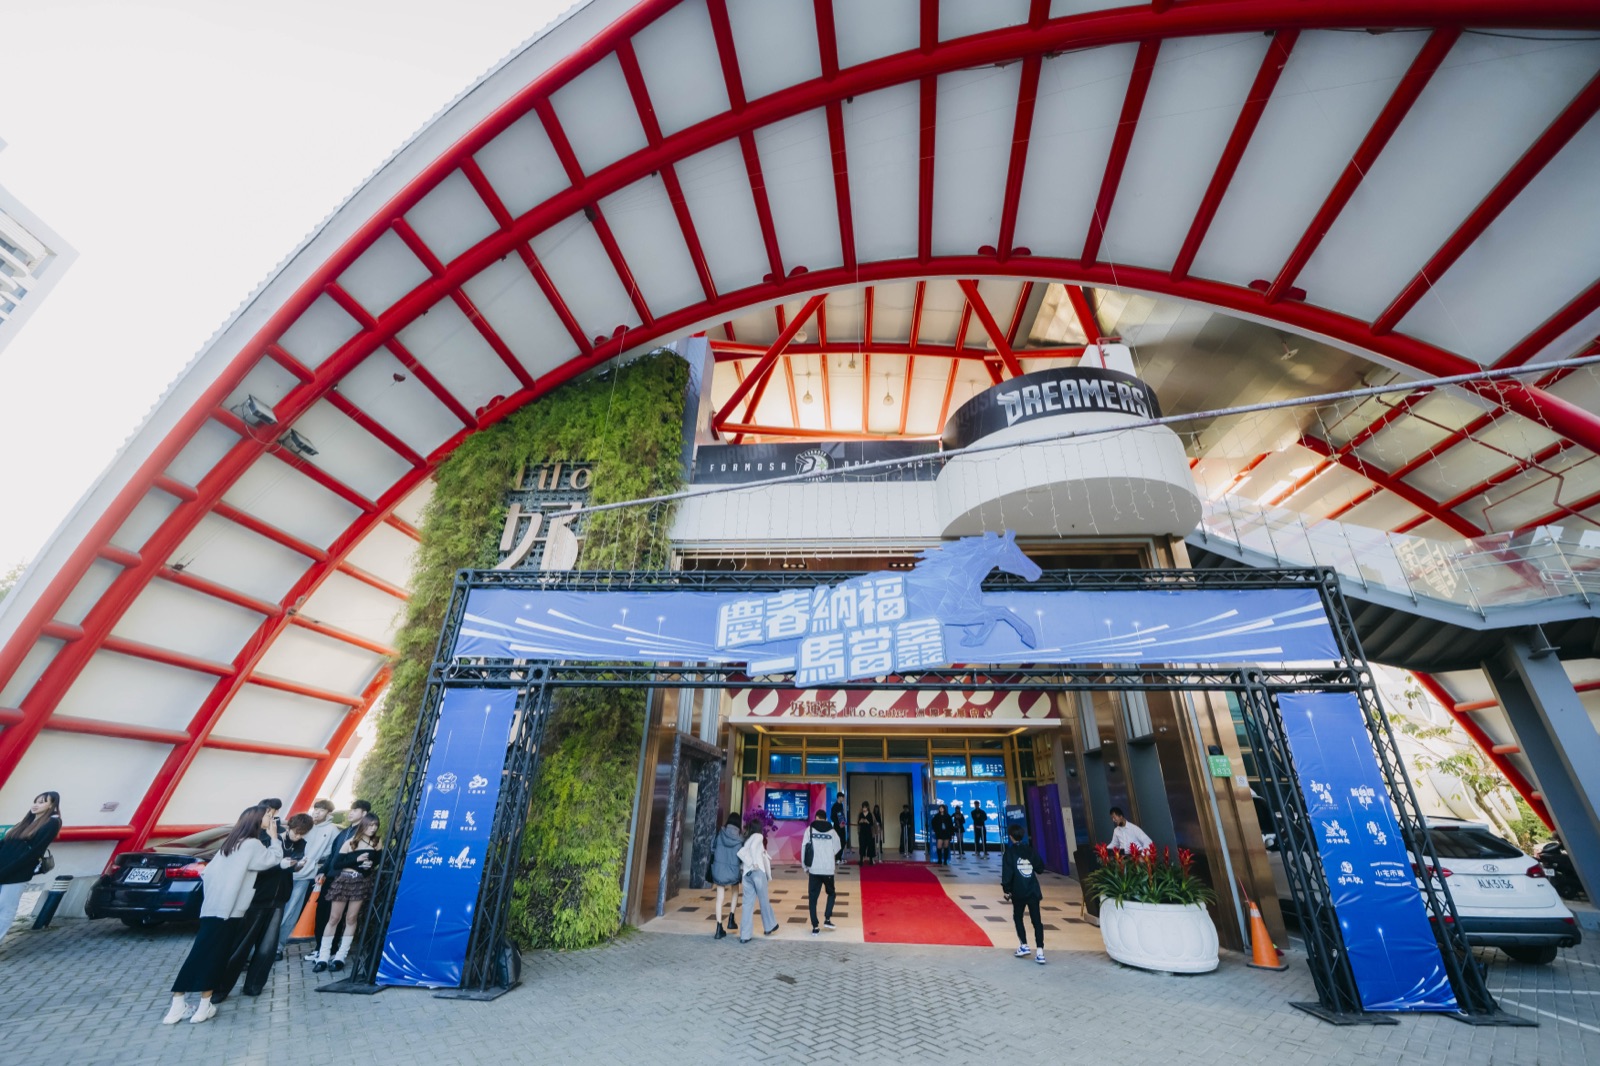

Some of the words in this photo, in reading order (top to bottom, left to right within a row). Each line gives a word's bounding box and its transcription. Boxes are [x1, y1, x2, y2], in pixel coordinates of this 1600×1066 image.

[997, 379, 1150, 427] DREAMERS
[709, 461, 787, 473] FORMOSA
[716, 575, 905, 648] 慶春納福
